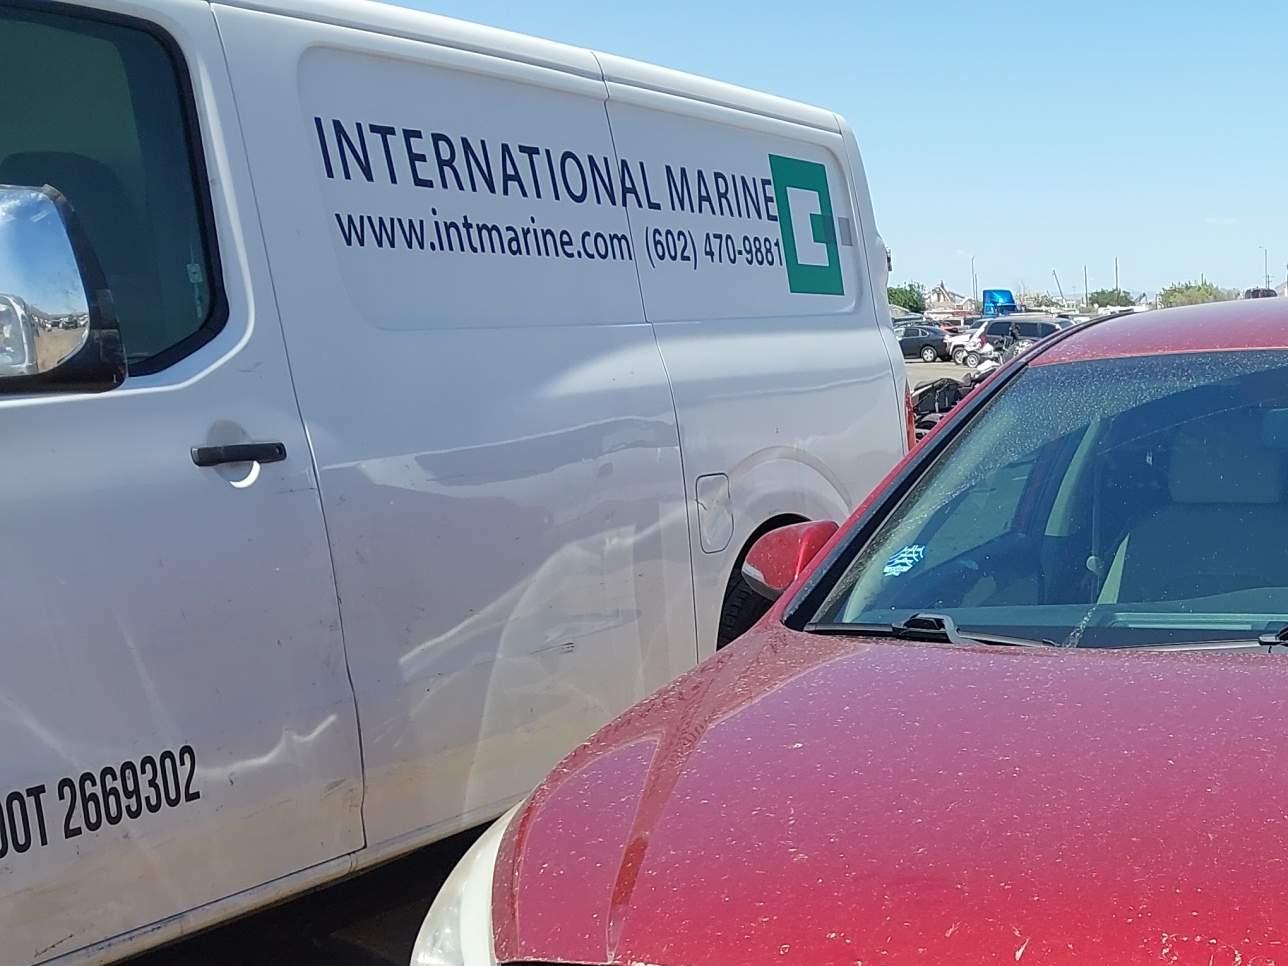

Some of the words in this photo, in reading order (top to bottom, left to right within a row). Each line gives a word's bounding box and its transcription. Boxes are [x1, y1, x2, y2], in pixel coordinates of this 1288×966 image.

[314, 116, 661, 211] INTERNATIONAL
[665, 164, 778, 222] MARINE
[335, 208, 633, 261] www.intmarine.com
[645, 224, 698, 270] (602)
[703, 231, 784, 267] 470-9881
[57, 745, 200, 839] 2669302
